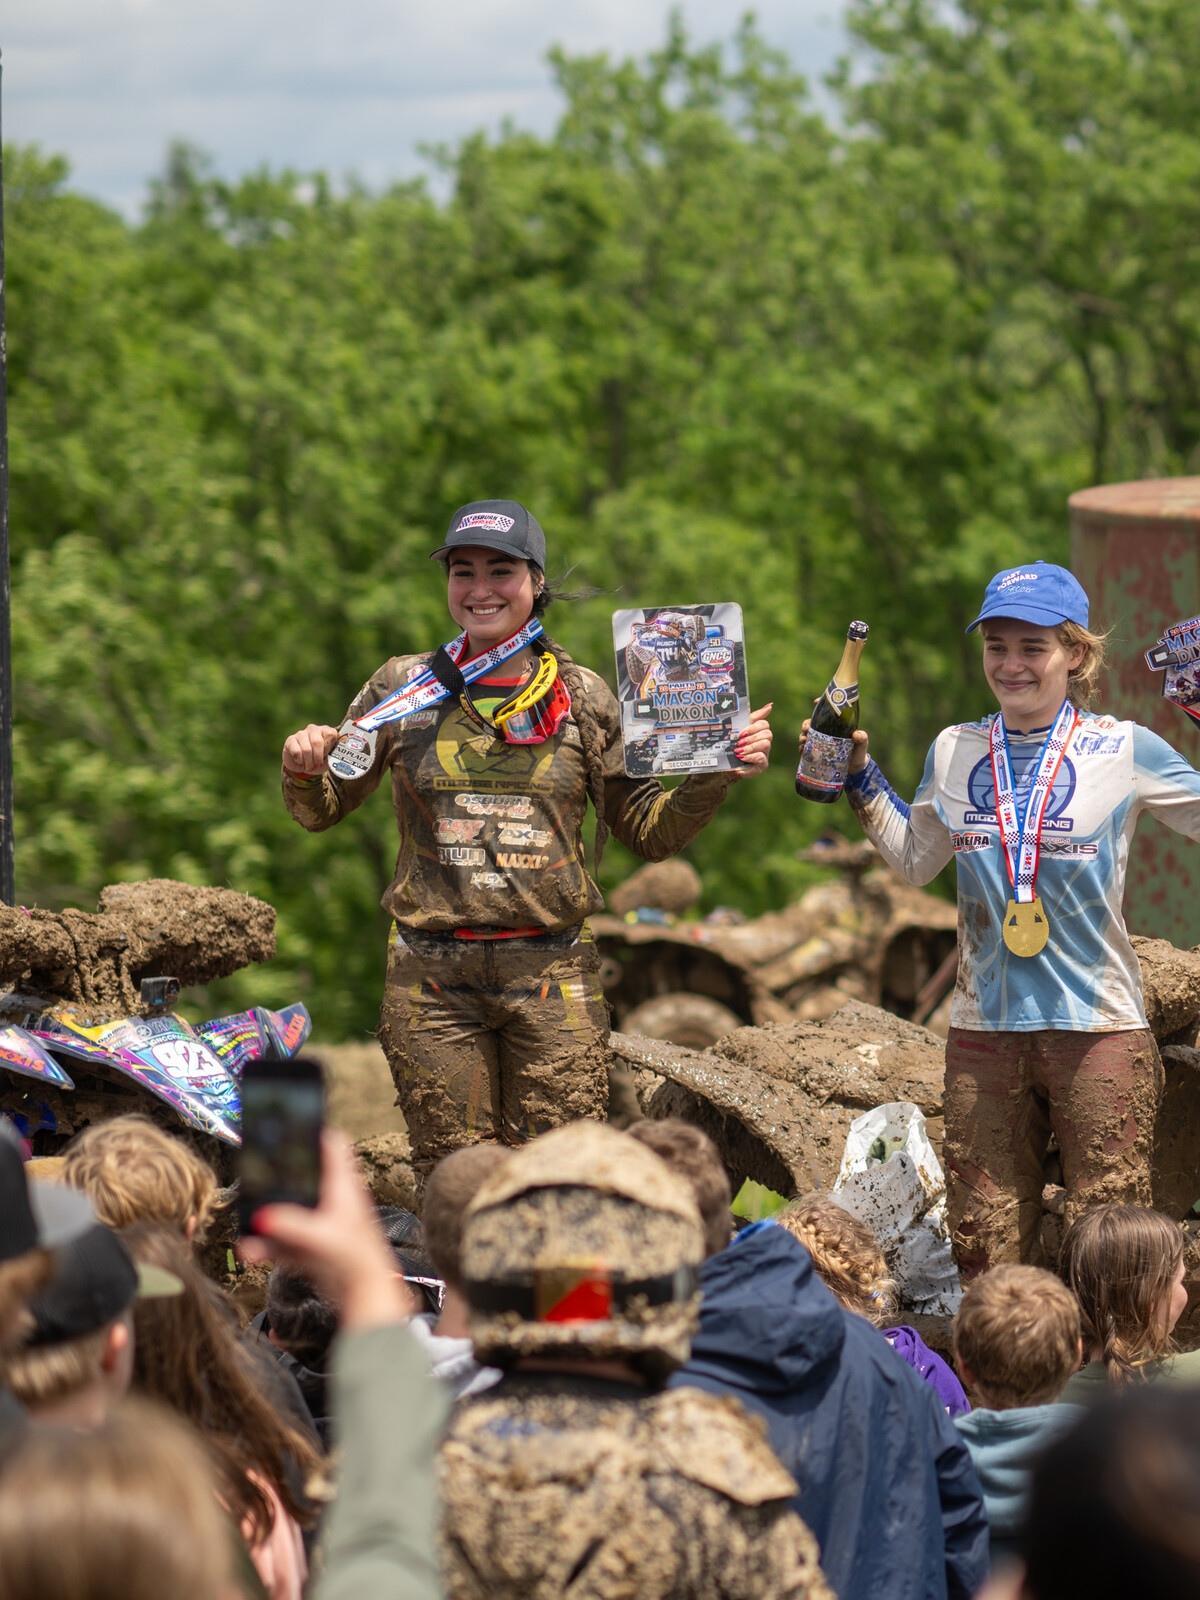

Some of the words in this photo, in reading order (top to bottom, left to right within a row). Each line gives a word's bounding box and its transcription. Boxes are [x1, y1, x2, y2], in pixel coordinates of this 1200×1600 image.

[997, 573, 1038, 592] FORWARD
[502, 638, 520, 655] AMA
[702, 651, 731, 661] GNCC
[653, 689, 718, 708] MASON
[660, 705, 715, 723] DIXON
[436, 779, 493, 789] MOOSE
[1003, 807, 1015, 829] AMA
[1040, 842, 1098, 854] AXIS
[1024, 847, 1033, 871] AMA
[282, 1013, 306, 1050] MAXXIS
[151, 1039, 226, 1079] 923
